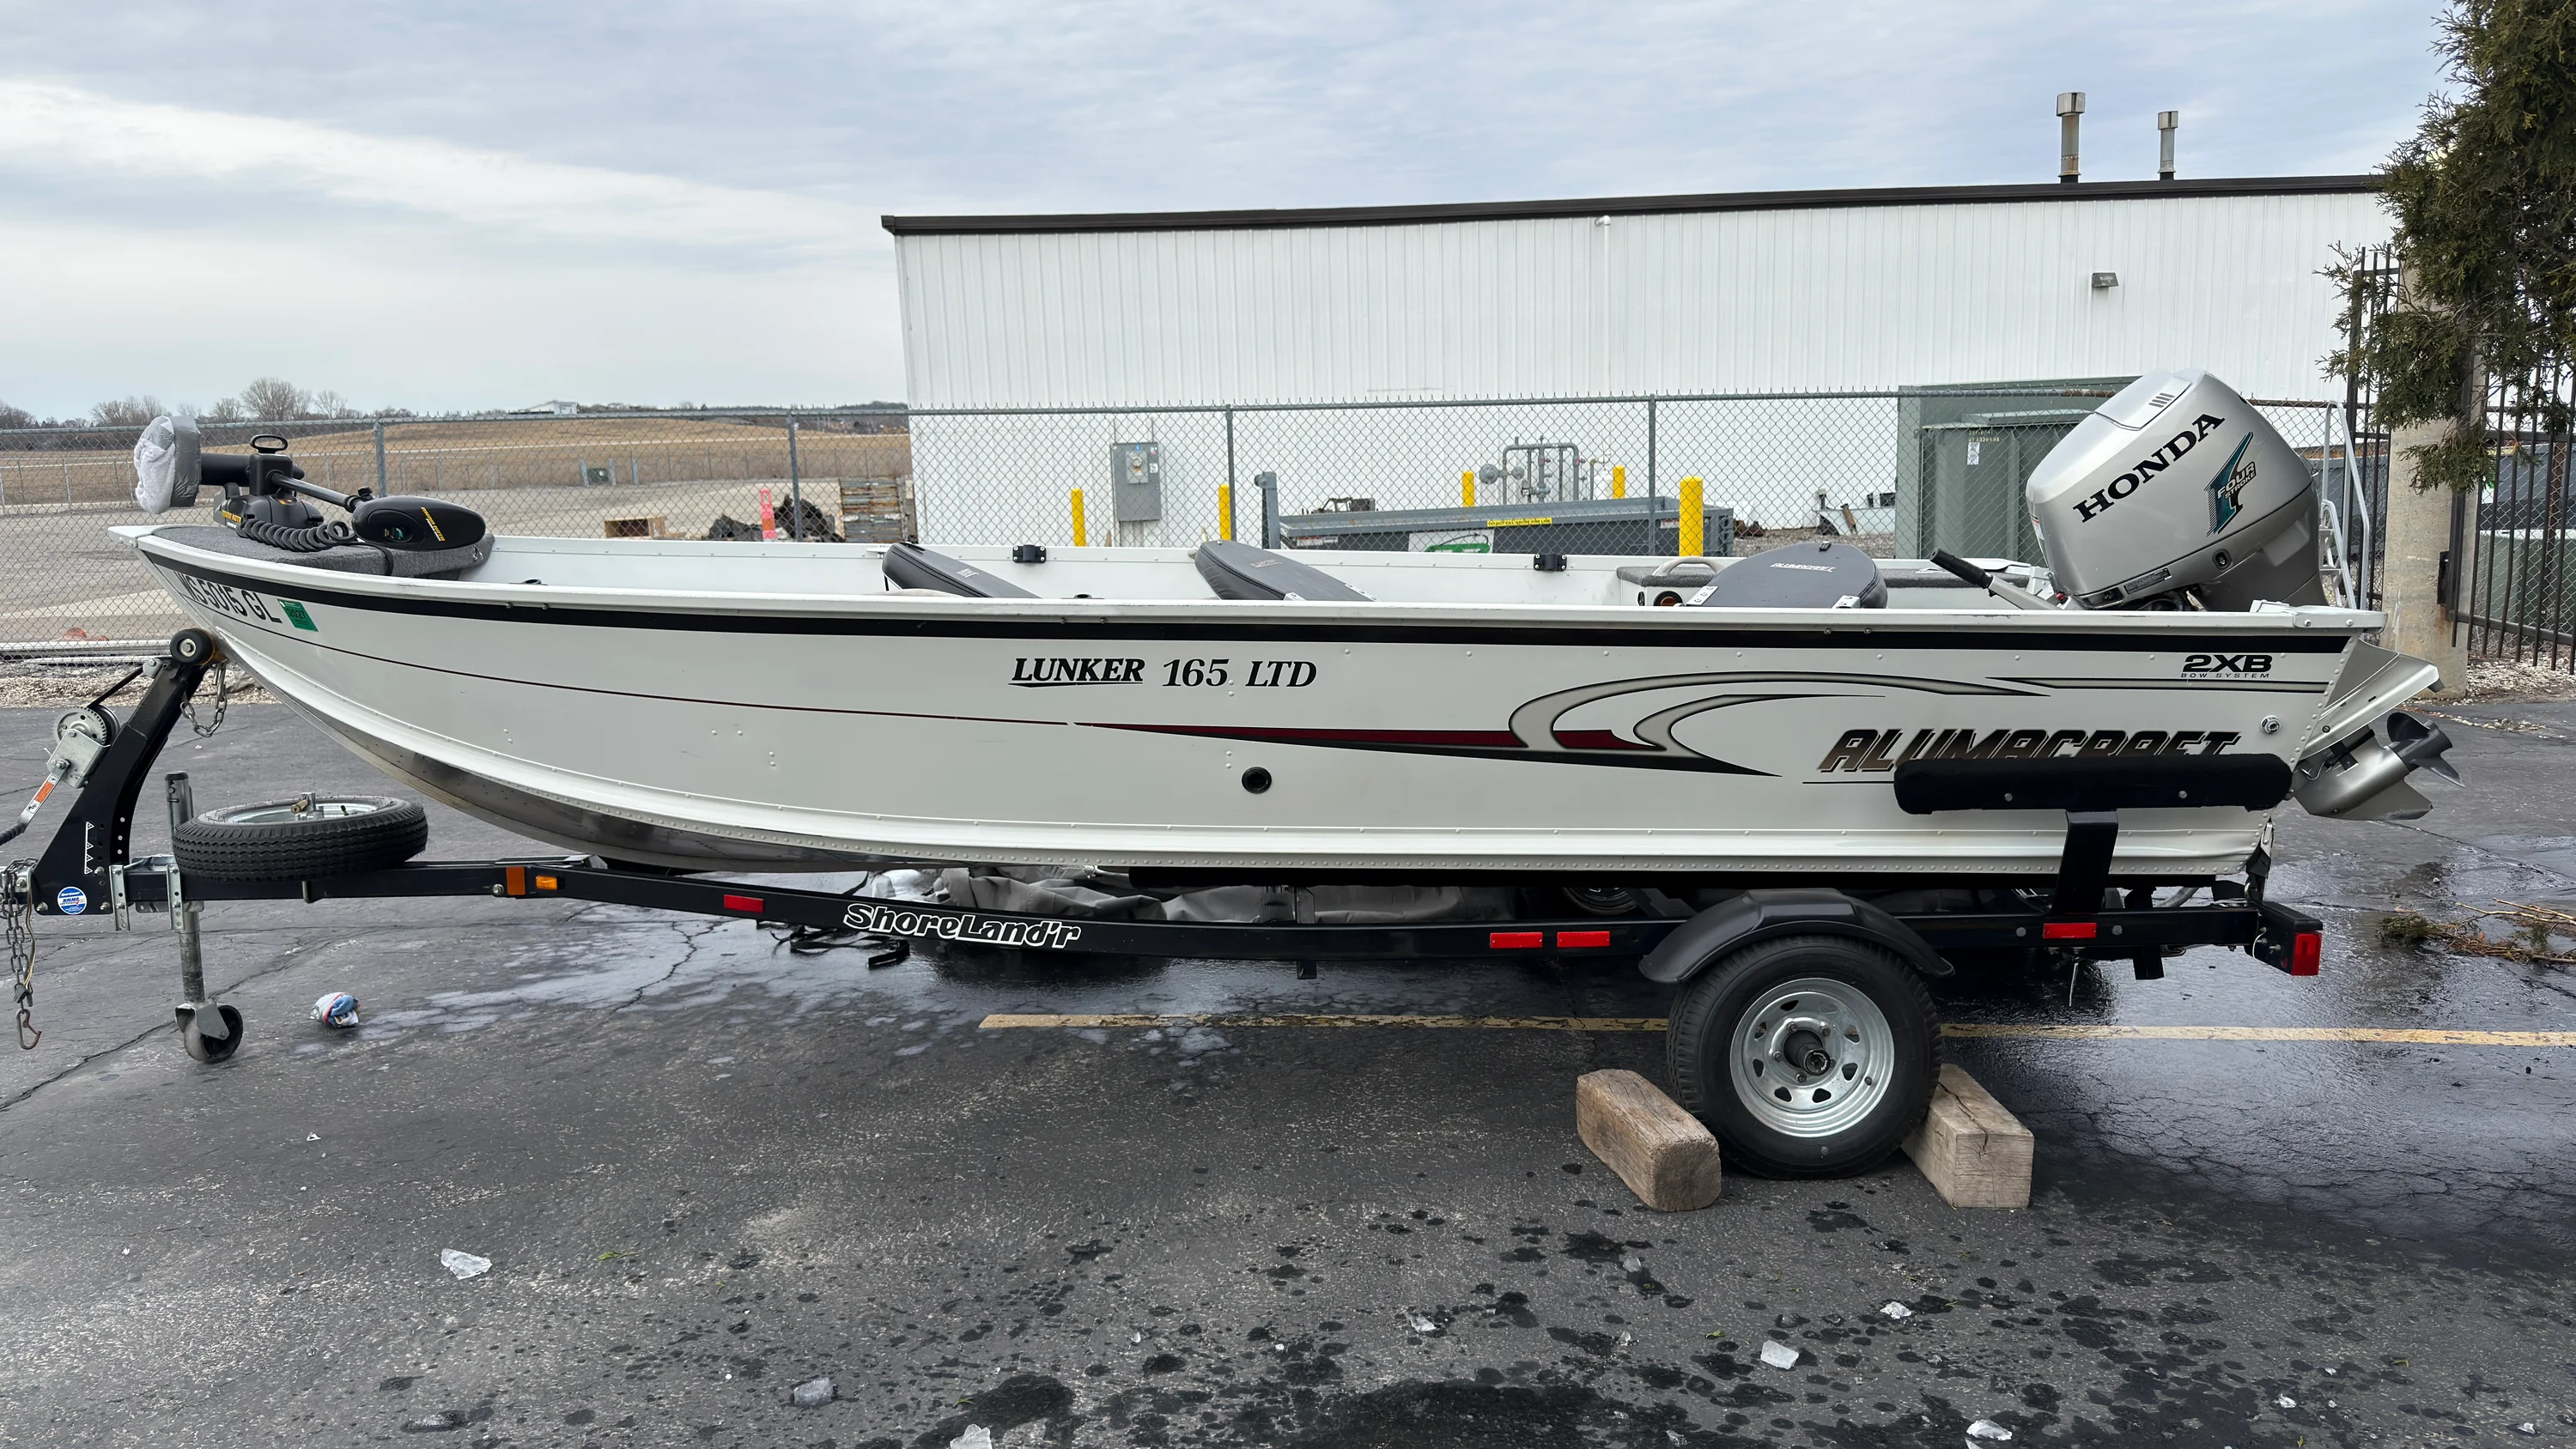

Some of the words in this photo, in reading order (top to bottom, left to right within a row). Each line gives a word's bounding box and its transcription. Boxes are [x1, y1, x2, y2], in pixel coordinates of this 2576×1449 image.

[2073, 414, 2225, 523] HONDA
[2217, 462, 2255, 499] FOUR
[2225, 471, 2256, 499] STROKE
[241, 590, 283, 624] GL
[1012, 658, 1145, 682] LUNKER
[1163, 658, 1230, 687] 165
[1245, 661, 1317, 687] LTD
[2183, 655, 2273, 672] 2XB
[1817, 728, 2242, 773] ALUMACRAFT
